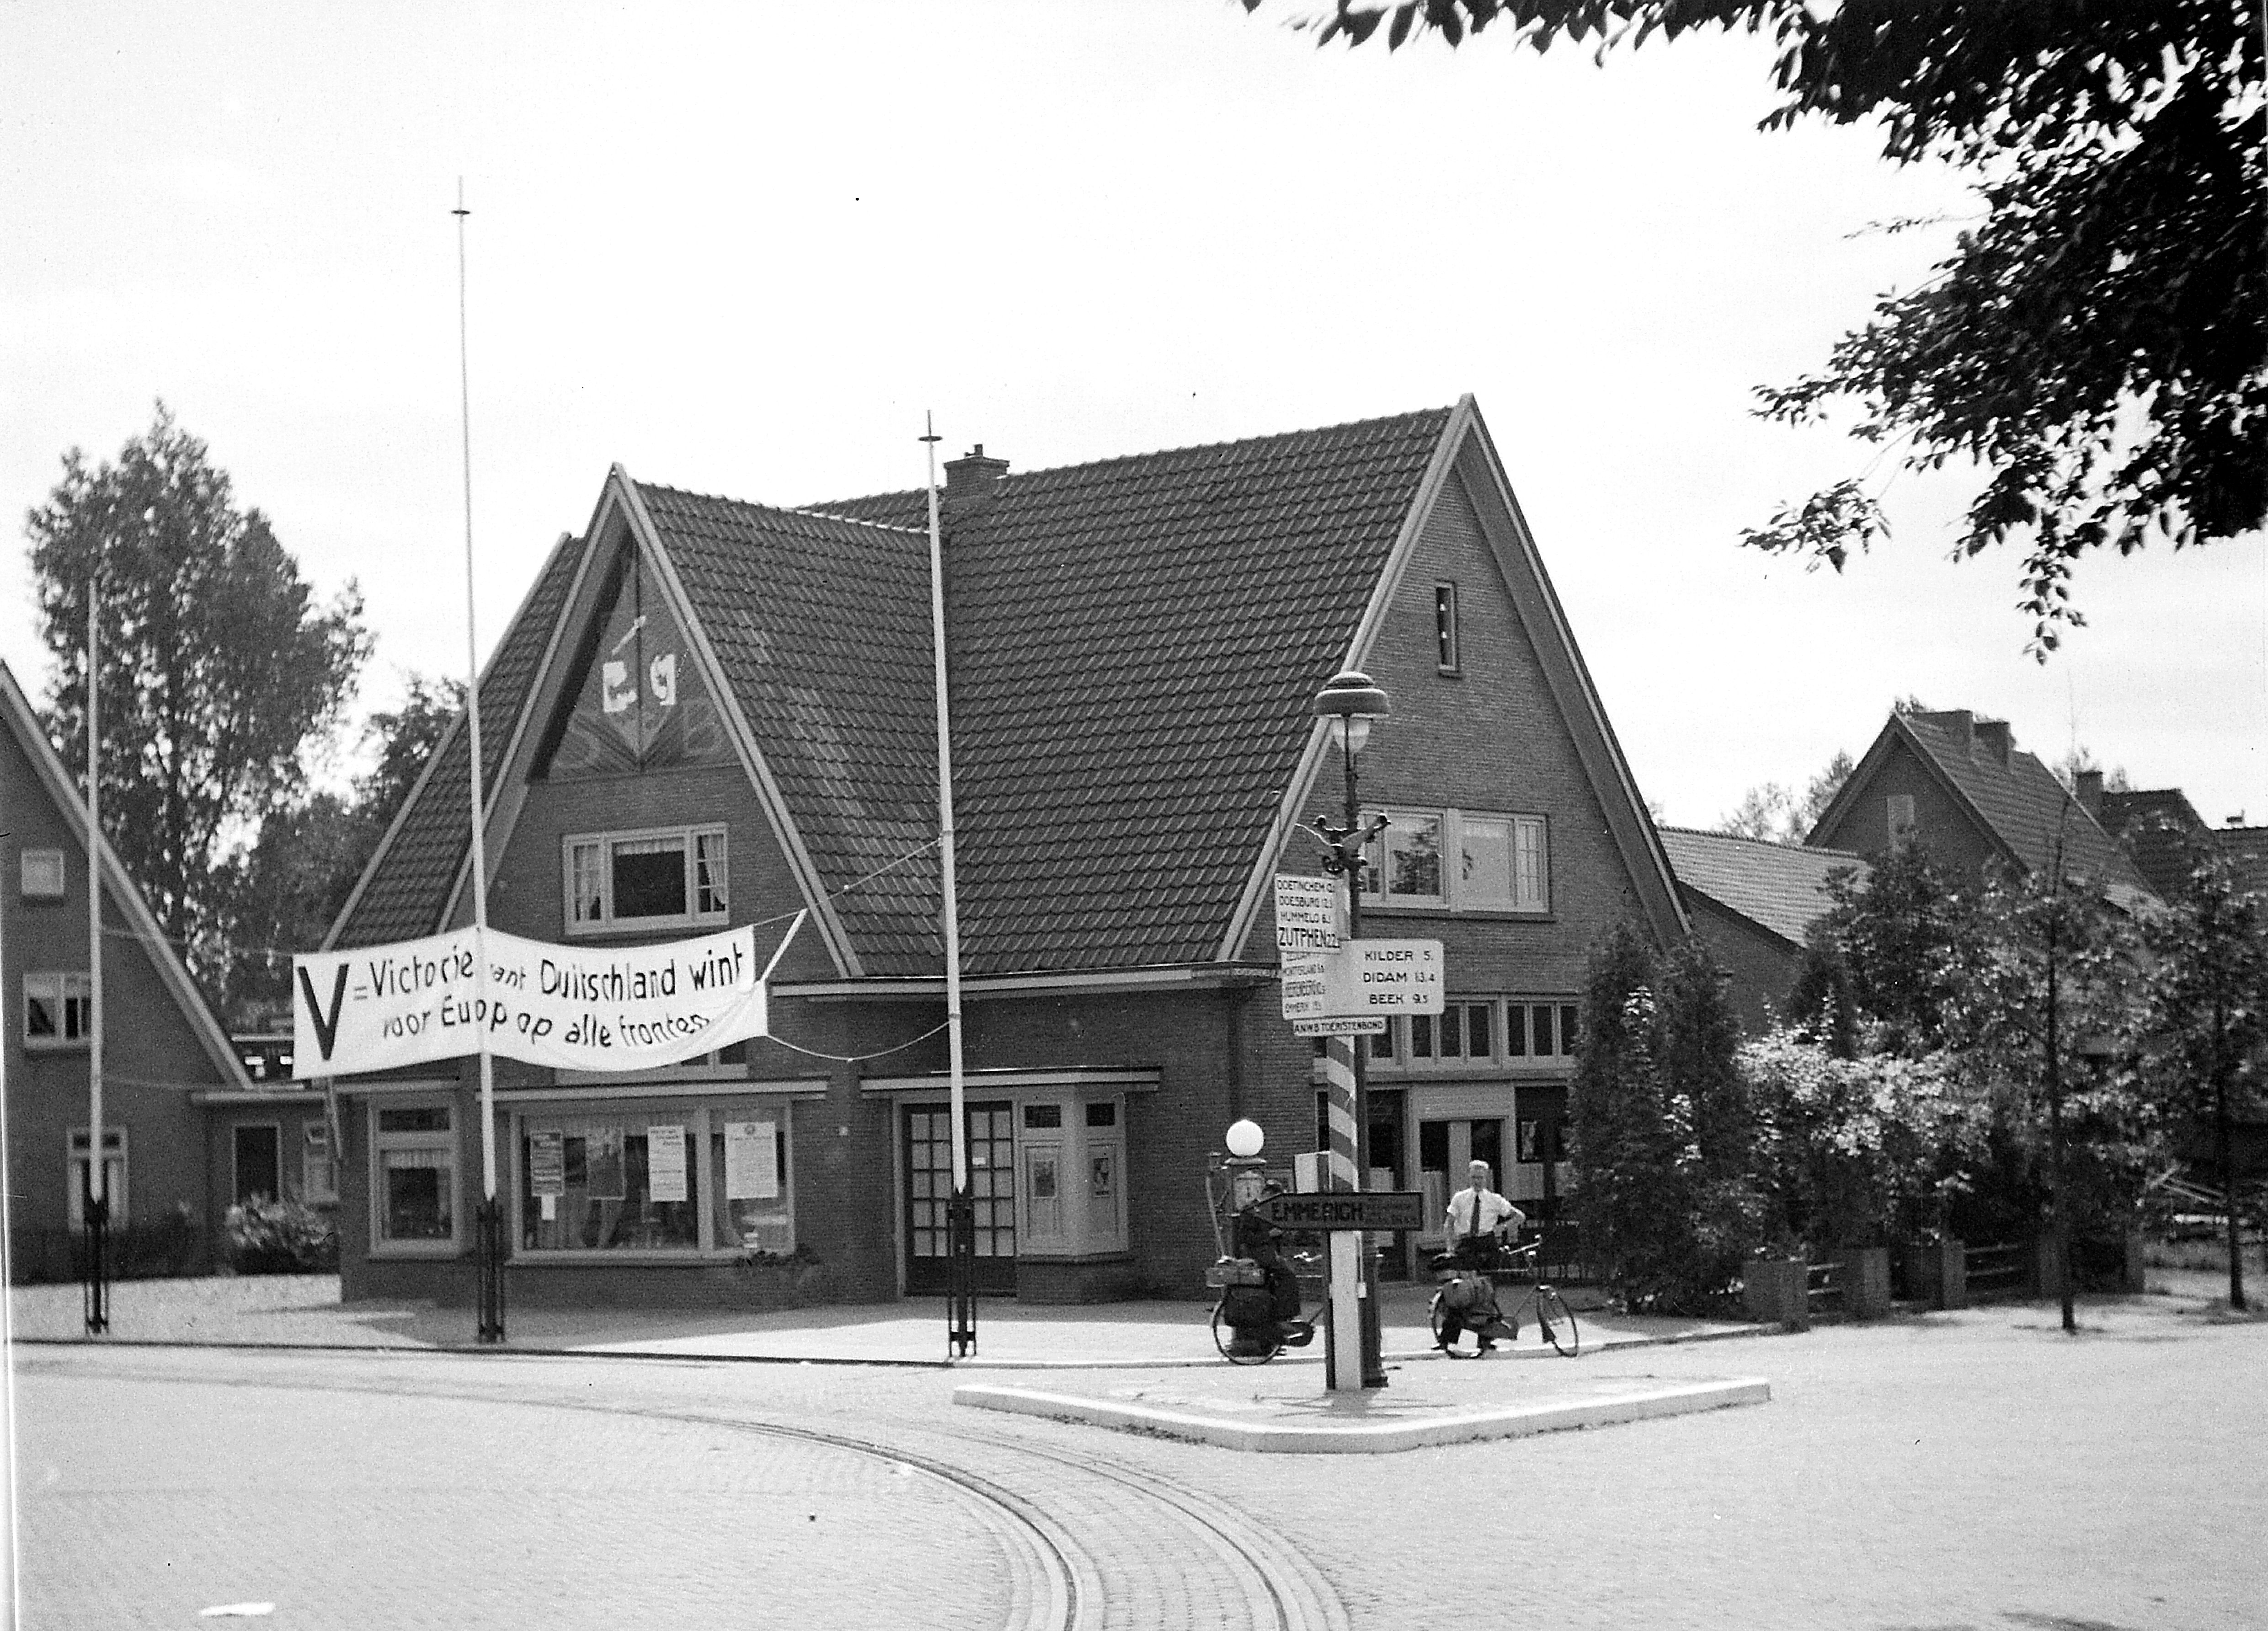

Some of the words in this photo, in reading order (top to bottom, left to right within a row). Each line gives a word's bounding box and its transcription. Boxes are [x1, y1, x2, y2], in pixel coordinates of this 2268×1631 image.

[1280, 896, 1319, 908] DOESBURG
[1281, 911, 1318, 923] HUMMELO
[1279, 926, 1326, 947] ZUTPHEN
[1365, 951, 1413, 961] KILDER
[1363, 972, 1407, 983] DIDAM
[297, 964, 349, 1060] V
[369, 945, 474, 996] Victorie
[490, 963, 526, 989] ant
[688, 943, 742, 991] wint
[1370, 994, 1403, 1004] BEEK
[565, 1014, 611, 1047] alle
[619, 1012, 710, 1047] fronten
